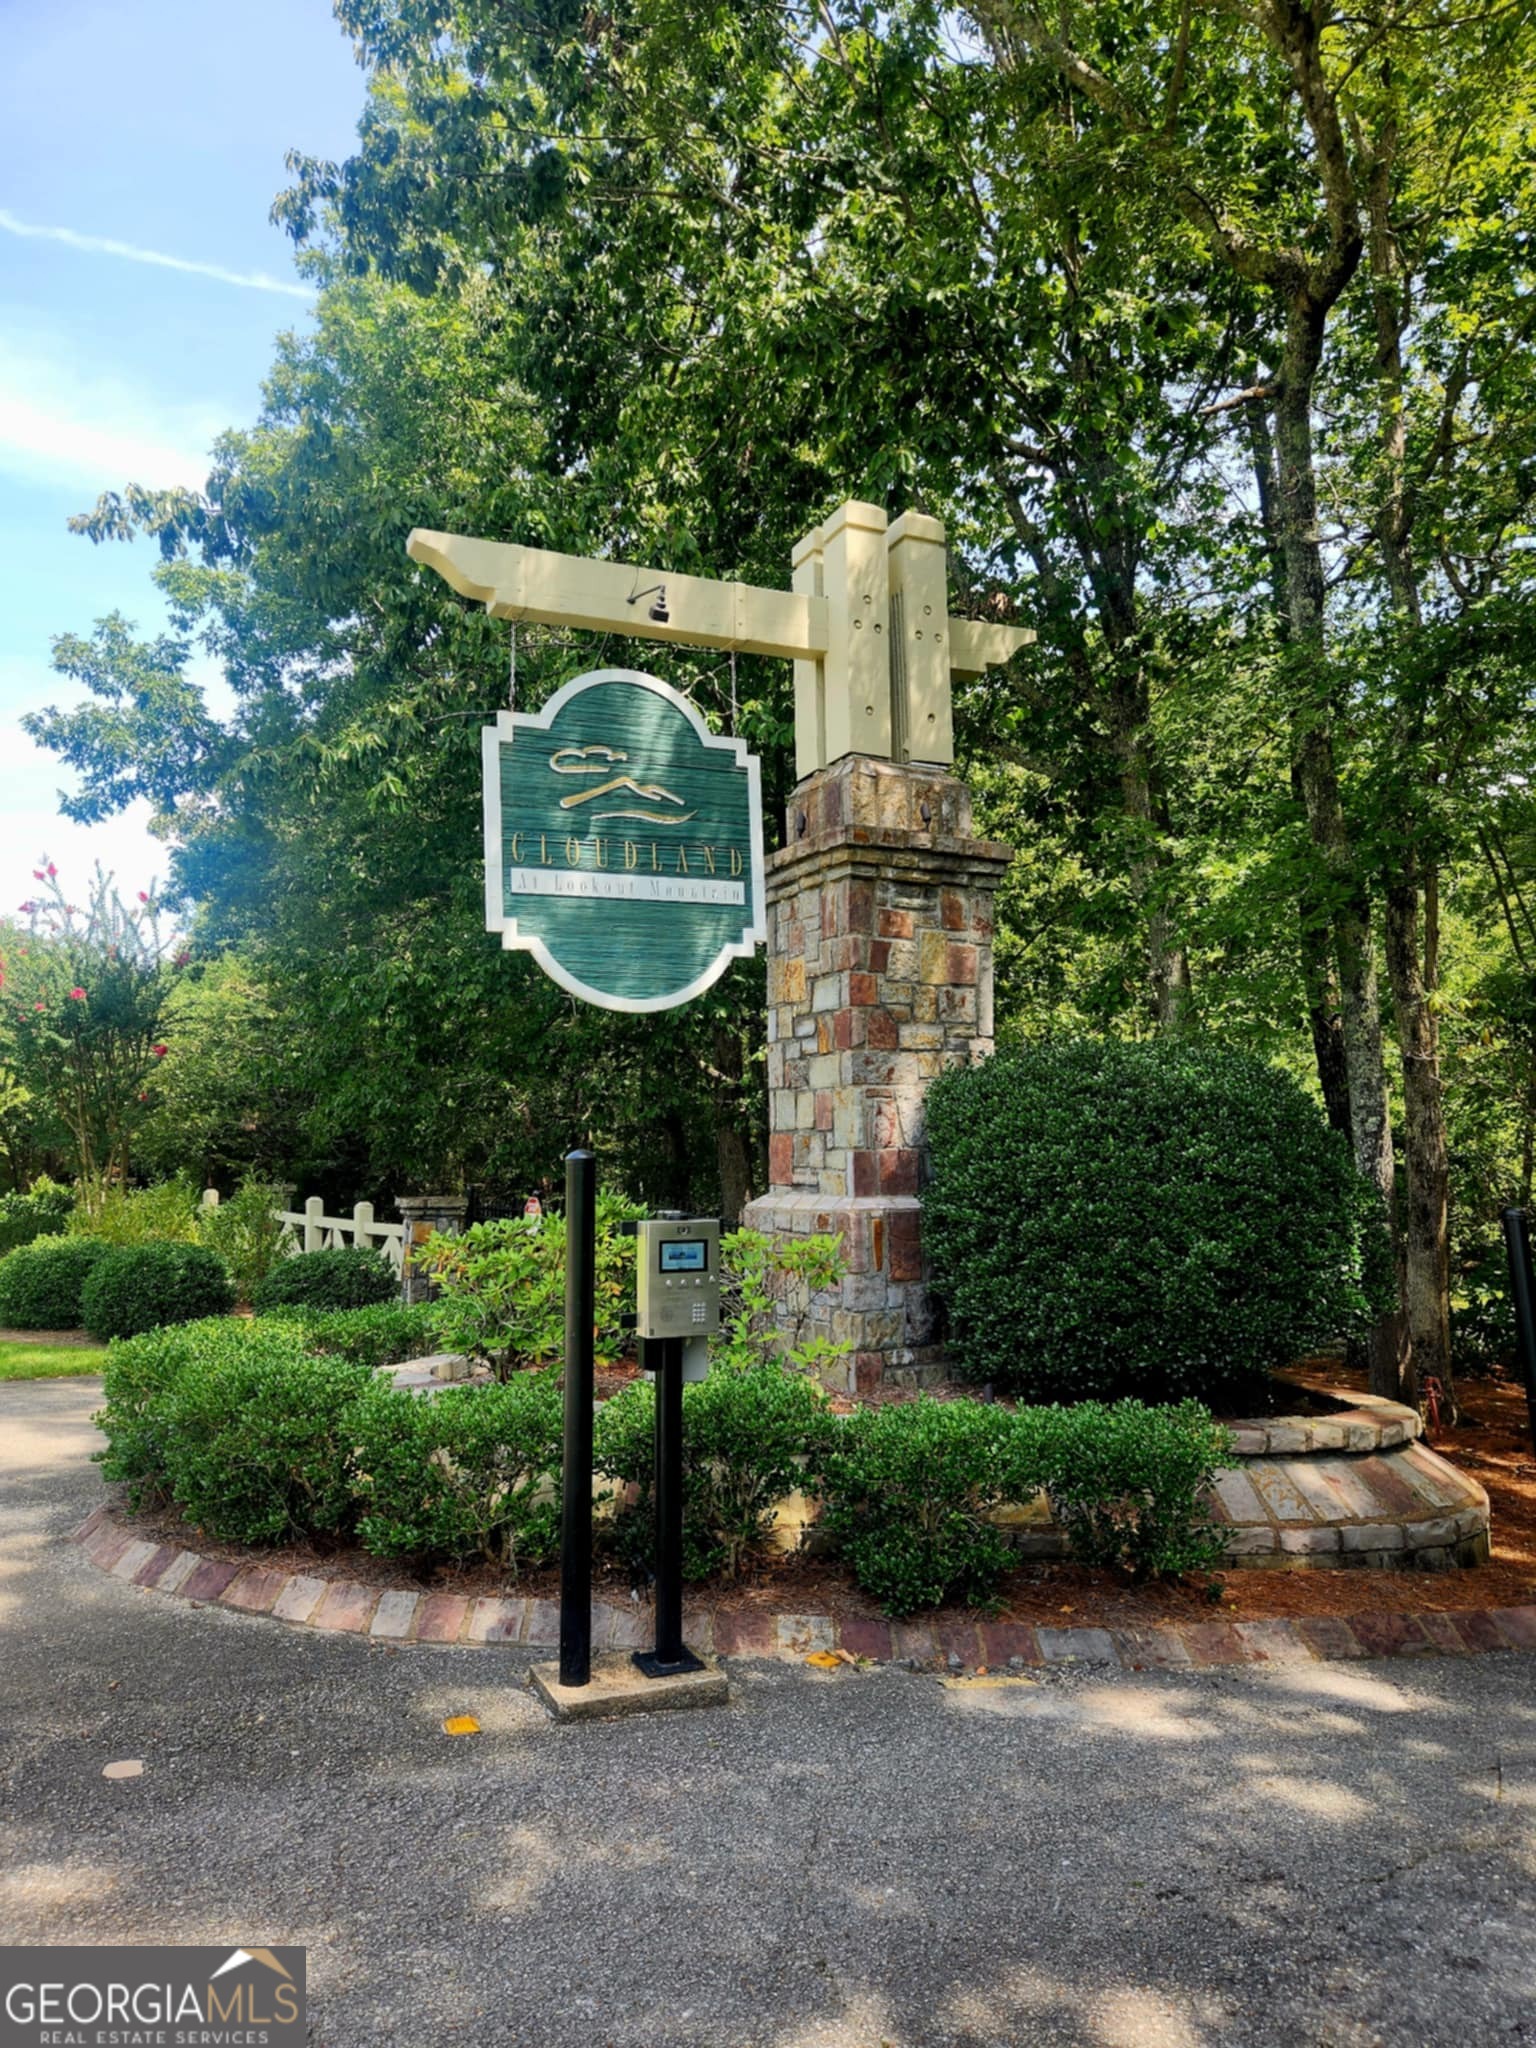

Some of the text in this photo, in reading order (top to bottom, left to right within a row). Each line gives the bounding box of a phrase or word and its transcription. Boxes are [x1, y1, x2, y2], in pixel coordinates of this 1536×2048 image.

[511, 832, 744, 876] CLOUDLAND
[517, 873, 539, 889] At
[554, 875, 635, 896] Lookout
